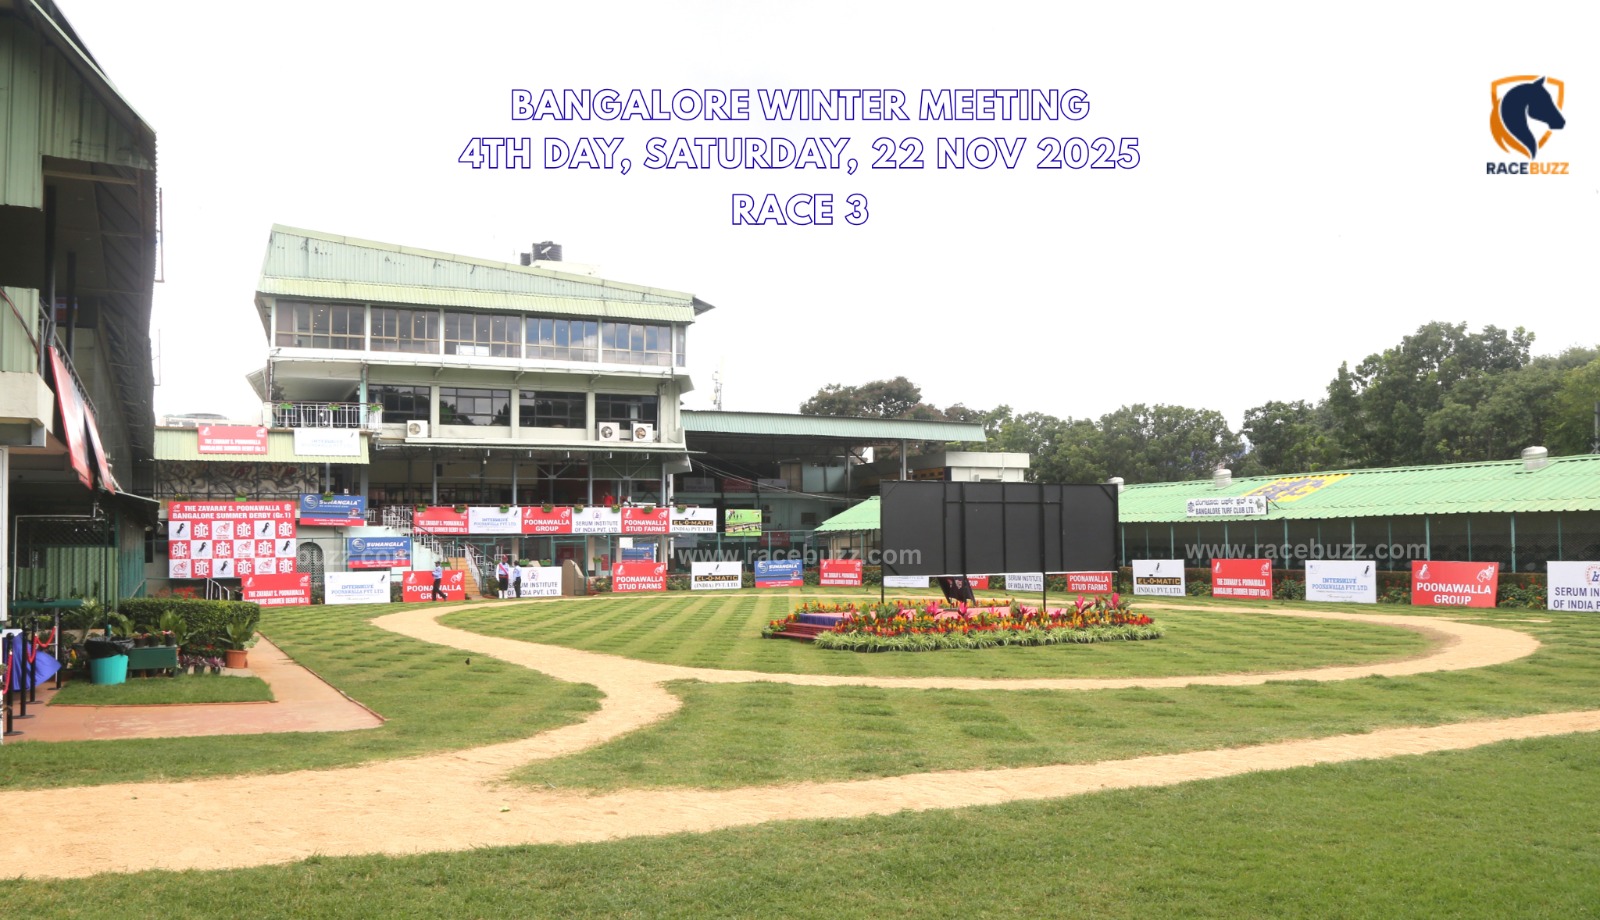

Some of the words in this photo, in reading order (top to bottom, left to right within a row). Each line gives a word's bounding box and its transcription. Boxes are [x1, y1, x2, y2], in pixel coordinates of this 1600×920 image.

[1416, 582, 1491, 594] POONAWALLA
[1555, 587, 1587, 596] SERUM
[1434, 595, 1471, 604] GROUP
[1553, 600, 1564, 608] OF
[1568, 600, 1593, 609] INDIA
